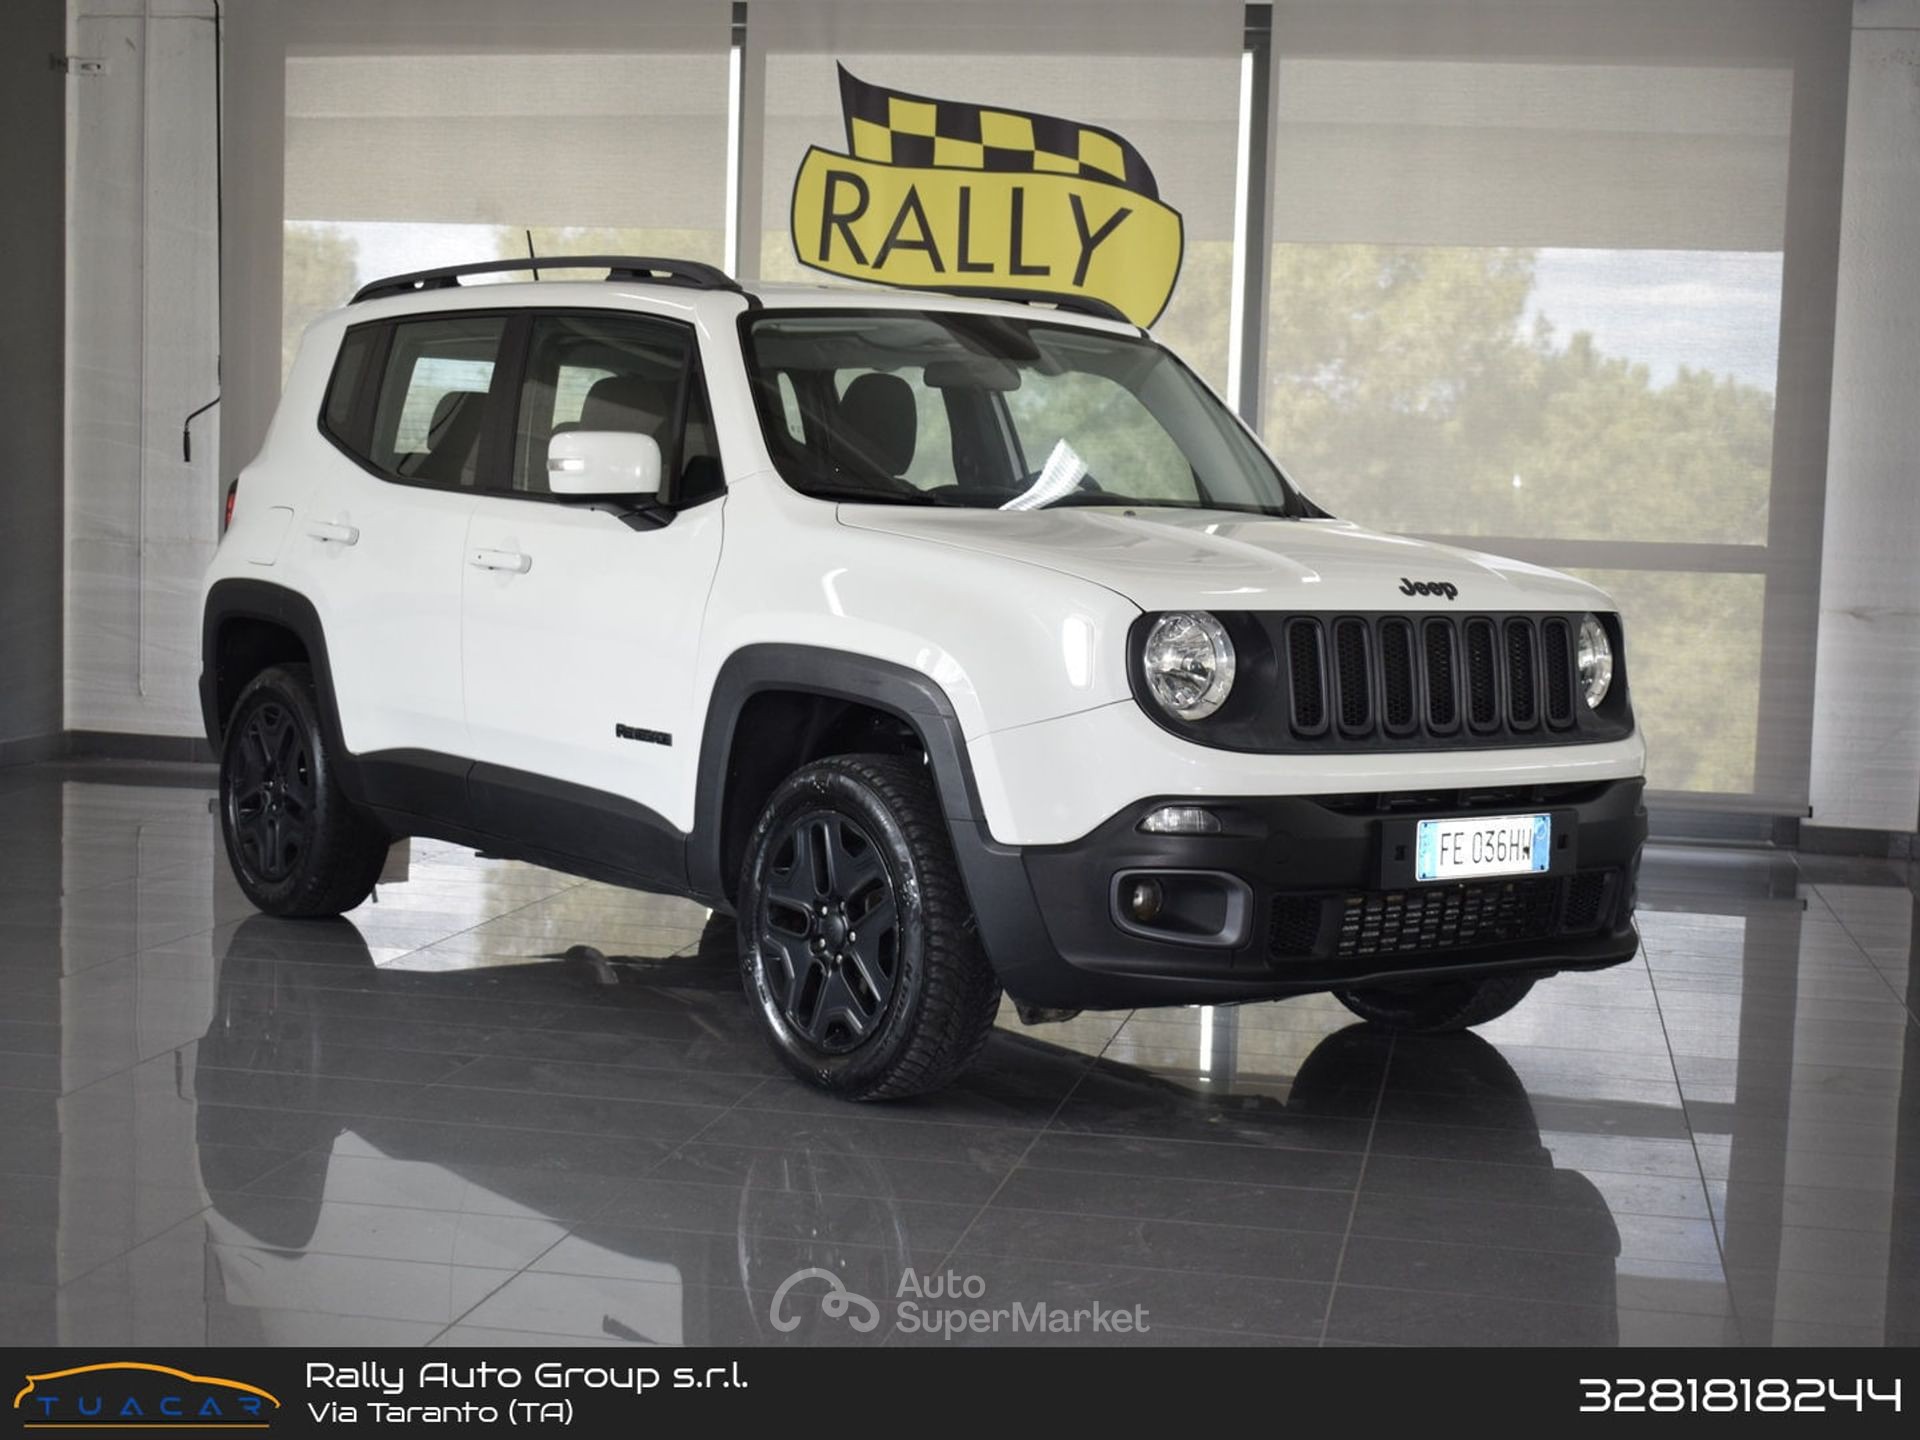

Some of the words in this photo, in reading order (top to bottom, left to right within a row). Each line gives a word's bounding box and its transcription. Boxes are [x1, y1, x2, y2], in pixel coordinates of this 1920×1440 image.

[818, 169, 1133, 288] RALLY
[1399, 578, 1458, 601] Jeep
[1440, 832, 1464, 866] FE
